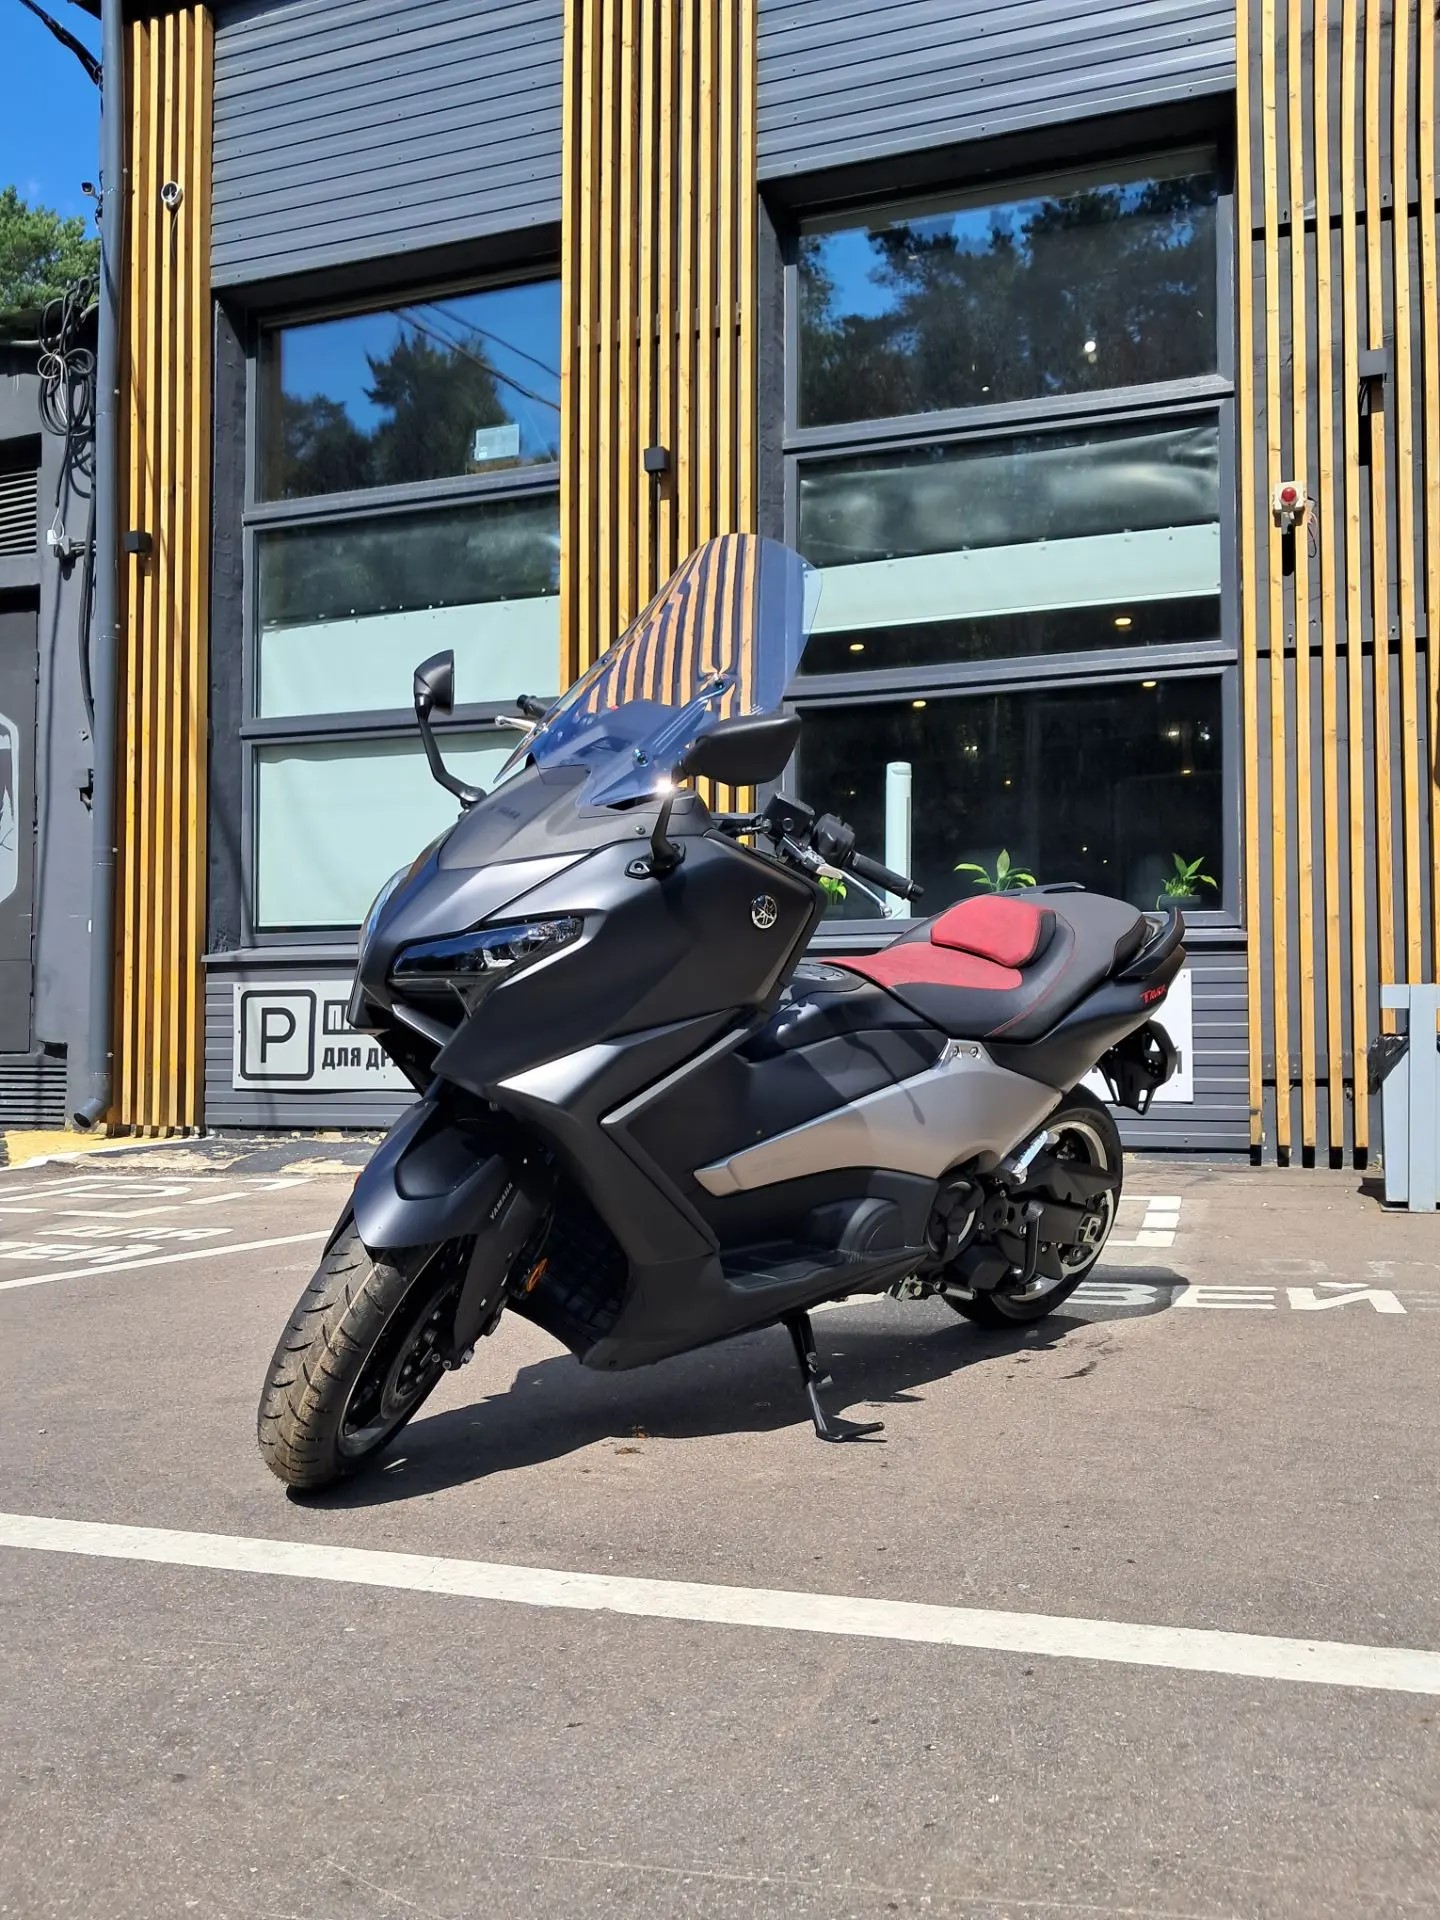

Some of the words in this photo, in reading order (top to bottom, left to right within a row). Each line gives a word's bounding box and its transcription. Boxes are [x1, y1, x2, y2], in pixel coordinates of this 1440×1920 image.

[260, 1007, 296, 1063] P
[322, 1047, 361, 1070] ДЛЯ
[366, 1047, 398, 1070] ДР
